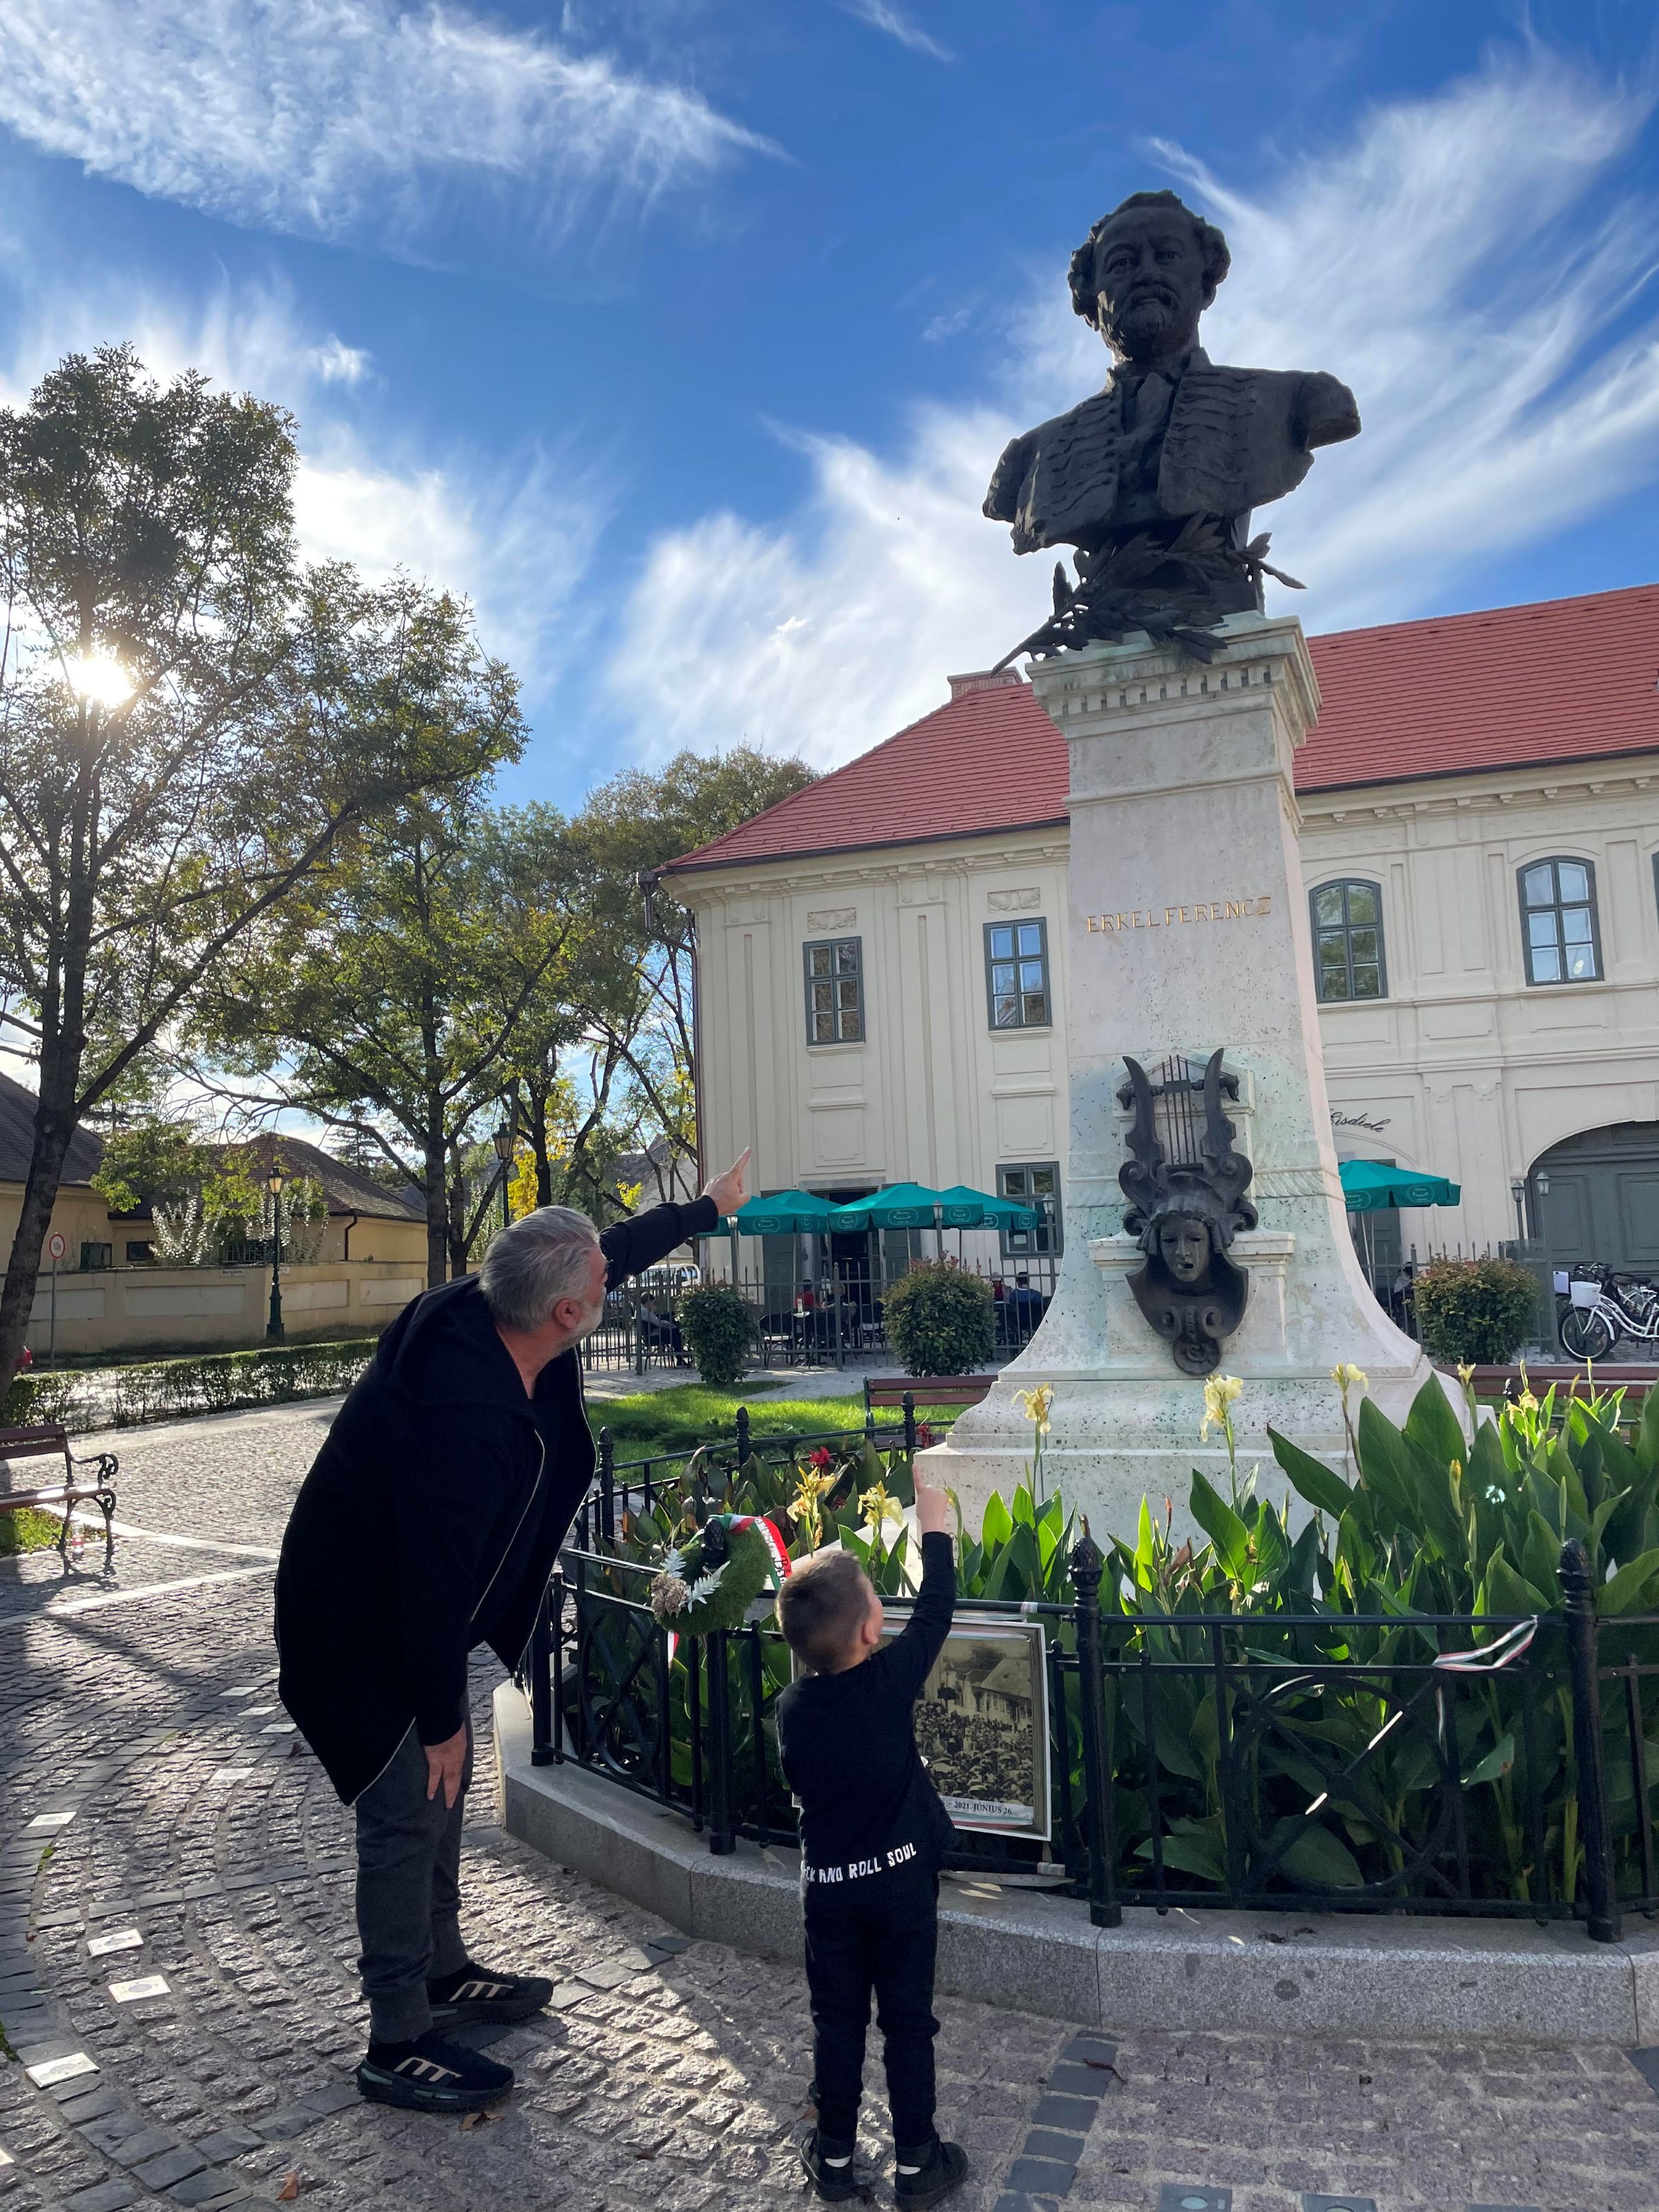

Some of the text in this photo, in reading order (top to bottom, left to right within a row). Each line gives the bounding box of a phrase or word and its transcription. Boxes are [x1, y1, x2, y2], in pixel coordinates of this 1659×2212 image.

[1087, 897, 1271, 932] ERKEL FERENCZ
[954, 1801, 972, 1810] 2021.
[973, 1801, 1002, 1814] JÚNIUS
[1004, 1807, 1013, 1815] 26.
[818, 1867, 843, 1883] AND
[849, 1857, 882, 1879] ROLL
[887, 1842, 917, 1867] SOUL
